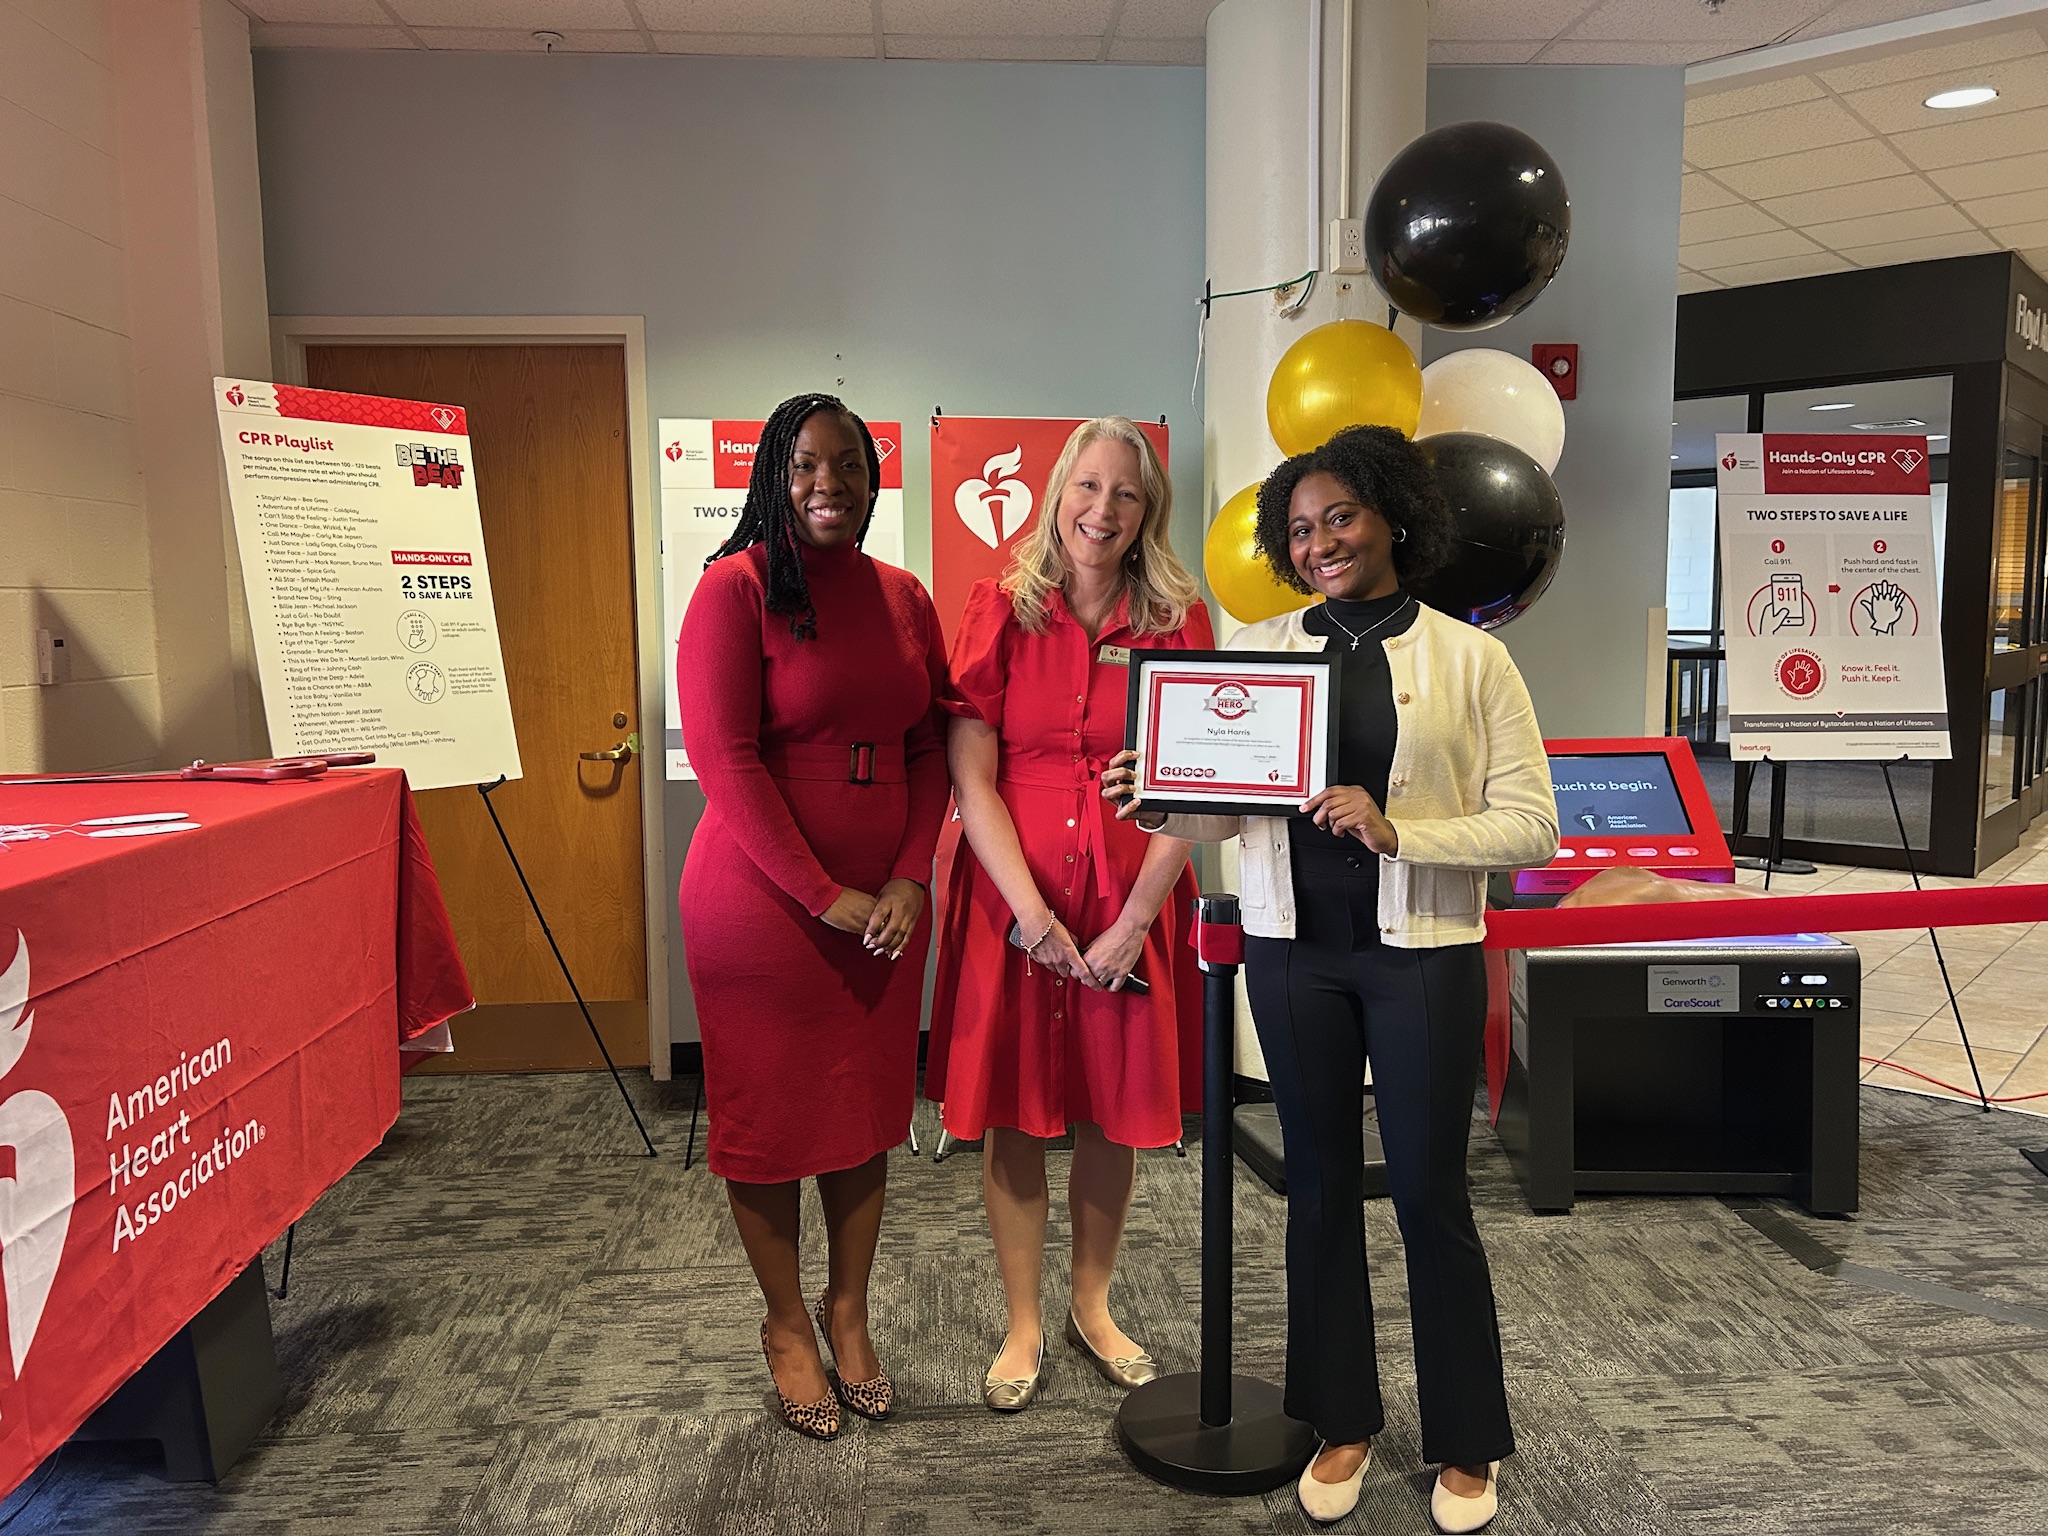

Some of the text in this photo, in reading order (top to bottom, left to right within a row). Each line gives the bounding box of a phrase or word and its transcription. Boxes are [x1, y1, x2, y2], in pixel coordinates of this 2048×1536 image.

[239, 432, 334, 452] CPR Playlist
[396, 443, 458, 467] BE THE
[1770, 452, 1886, 465] Hands-Only CPR
[413, 463, 464, 489] BEAT
[694, 507, 727, 517] TWO
[1747, 511, 1908, 520] TWO STEPS TO SAVE A LIFE
[394, 554, 450, 562] HANDS-ONLY
[401, 576, 471, 589] 2 STEPS
[1778, 588, 1797, 601] 911
[1774, 659, 1782, 682] NATION
[1789, 648, 1821, 662] LIFESAVERS
[1872, 675, 1892, 683] Keep
[1208, 728, 1226, 736] Nyla
[1552, 780, 1657, 792] ouch to begin.
[106, 1038, 232, 1141] American
[110, 1110, 191, 1195] Heart
